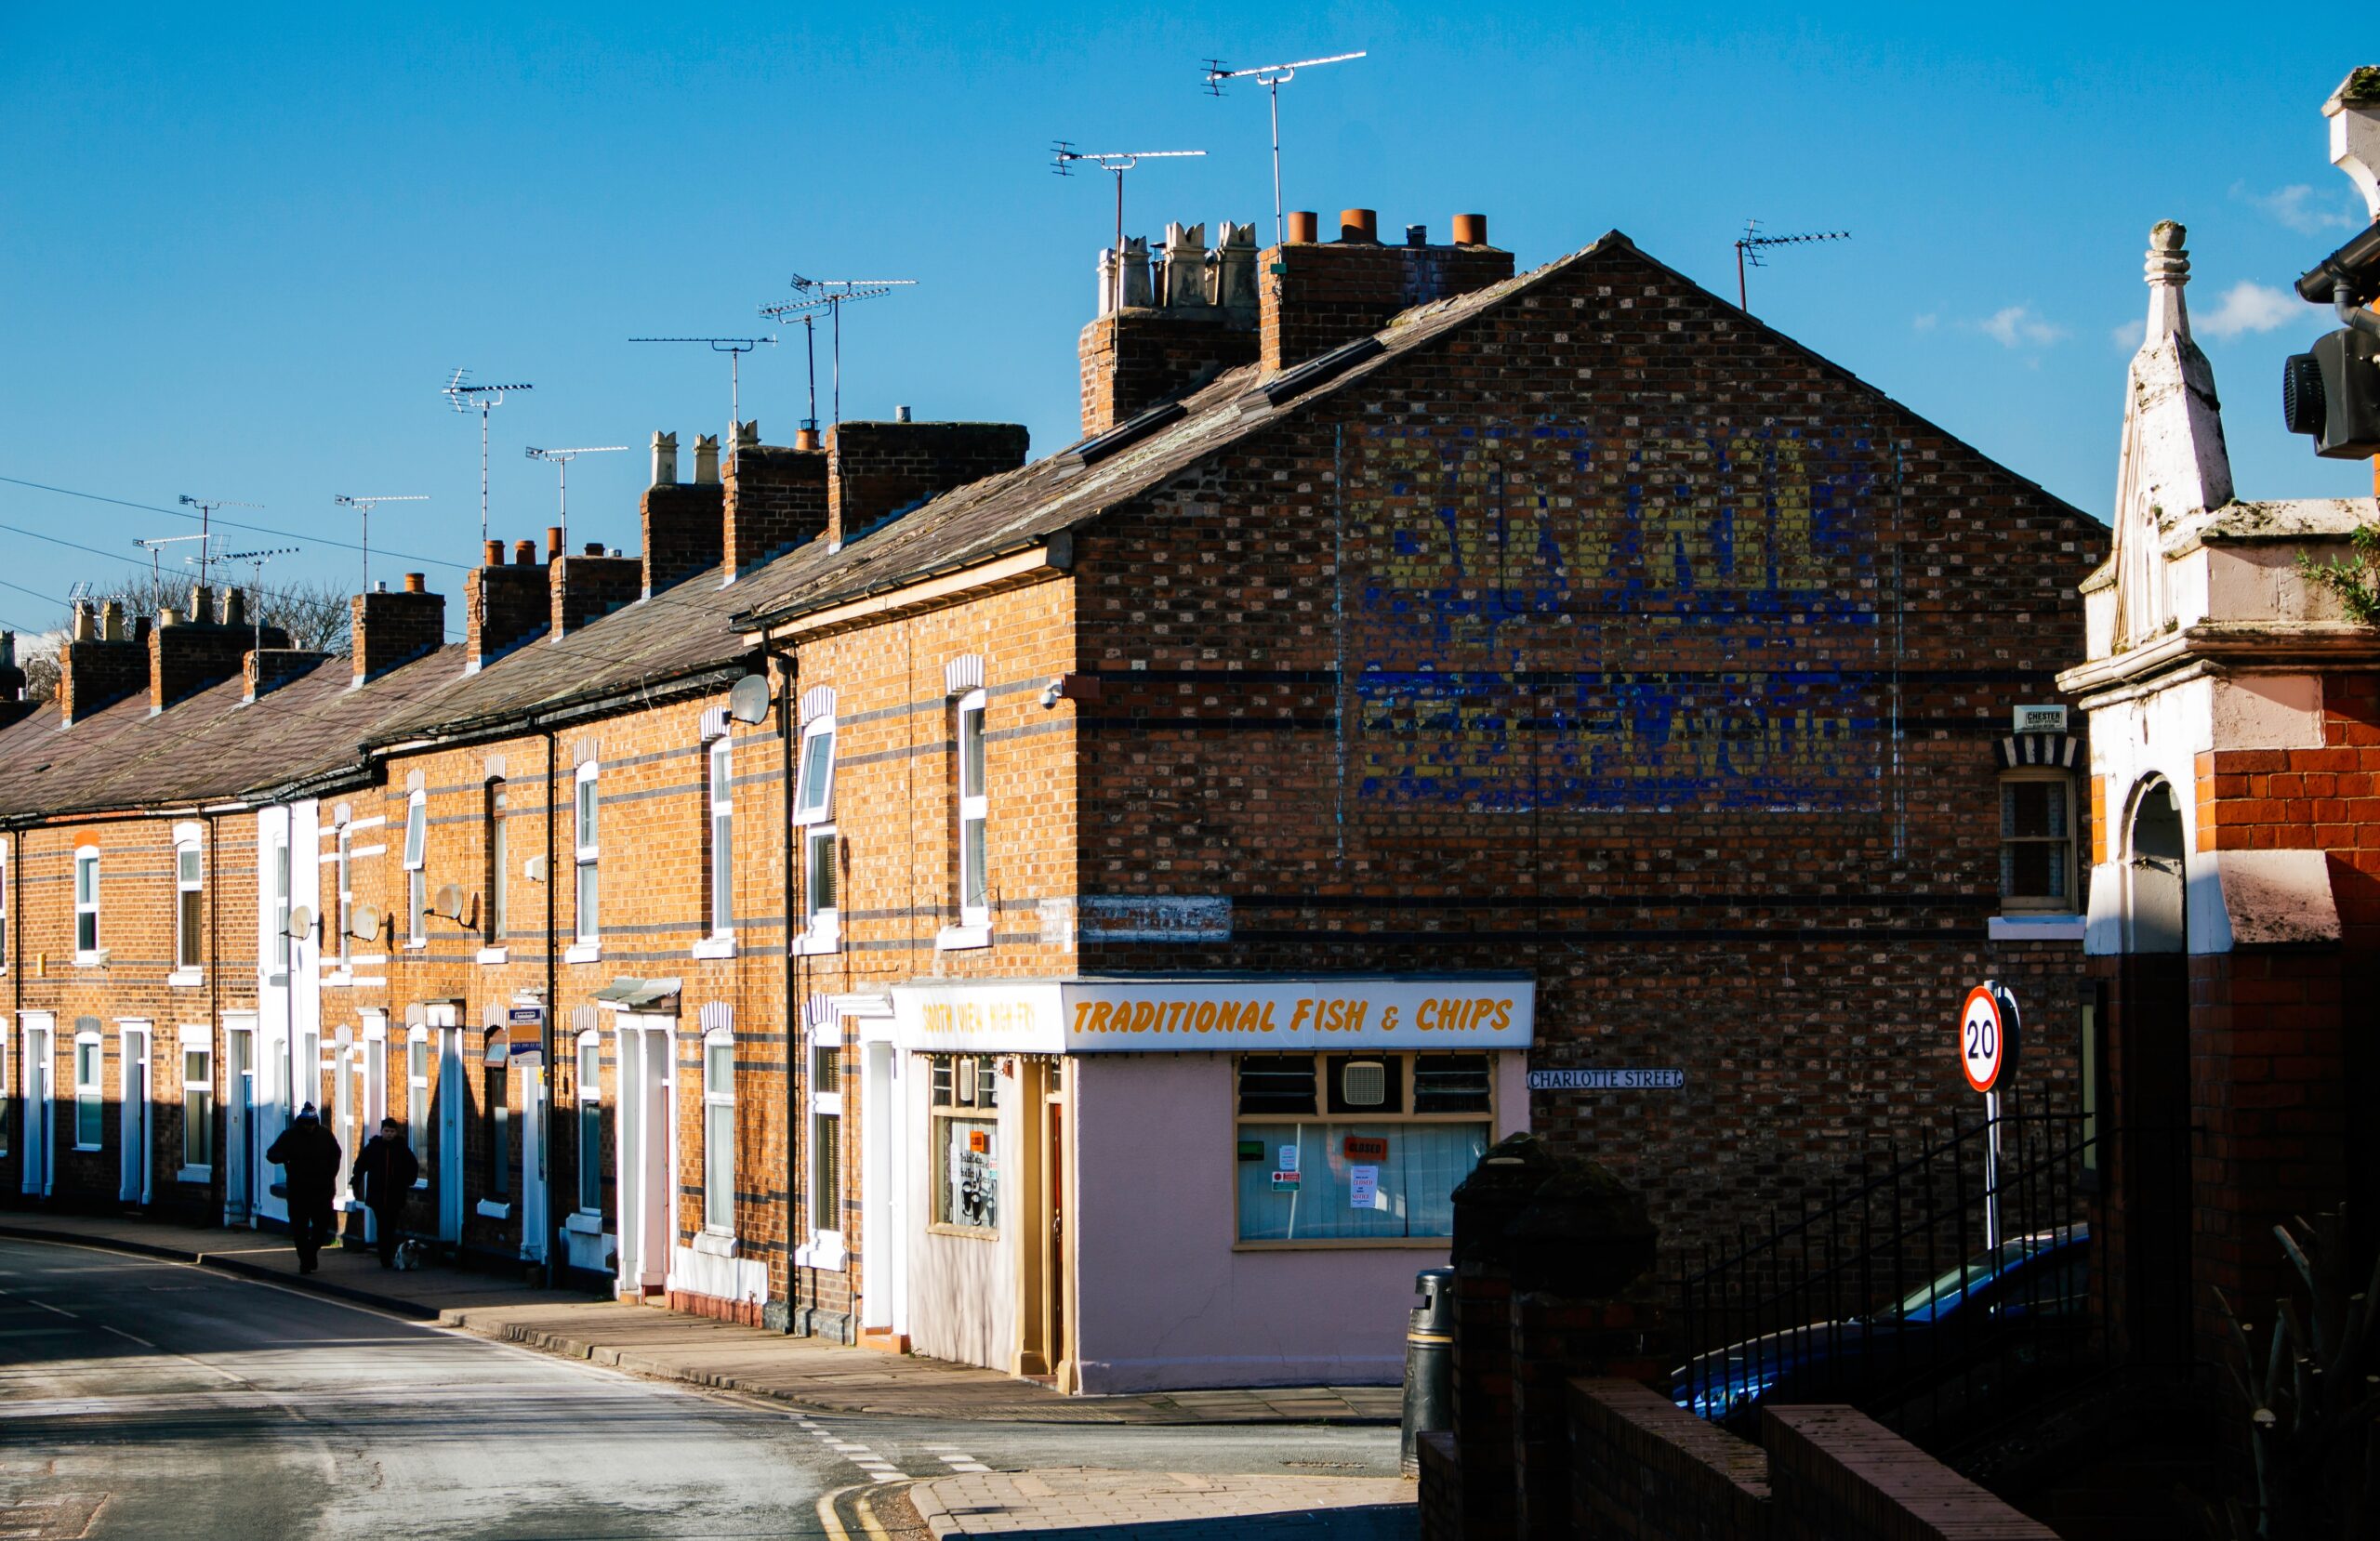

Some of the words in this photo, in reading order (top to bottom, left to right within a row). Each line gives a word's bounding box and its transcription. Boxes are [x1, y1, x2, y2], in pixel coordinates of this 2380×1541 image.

[2028, 712, 2060, 720] CHESTER
[1074, 1000, 1276, 1034] TRADITIONAL
[1289, 998, 1368, 1032] FISH
[1381, 1006, 1399, 1031] &
[1416, 998, 1514, 1031] CHIPS
[1967, 1020, 1995, 1060] 20
[1530, 1071, 1619, 1087] CHARLOTTE
[1349, 1143, 1382, 1153] CLOSED
